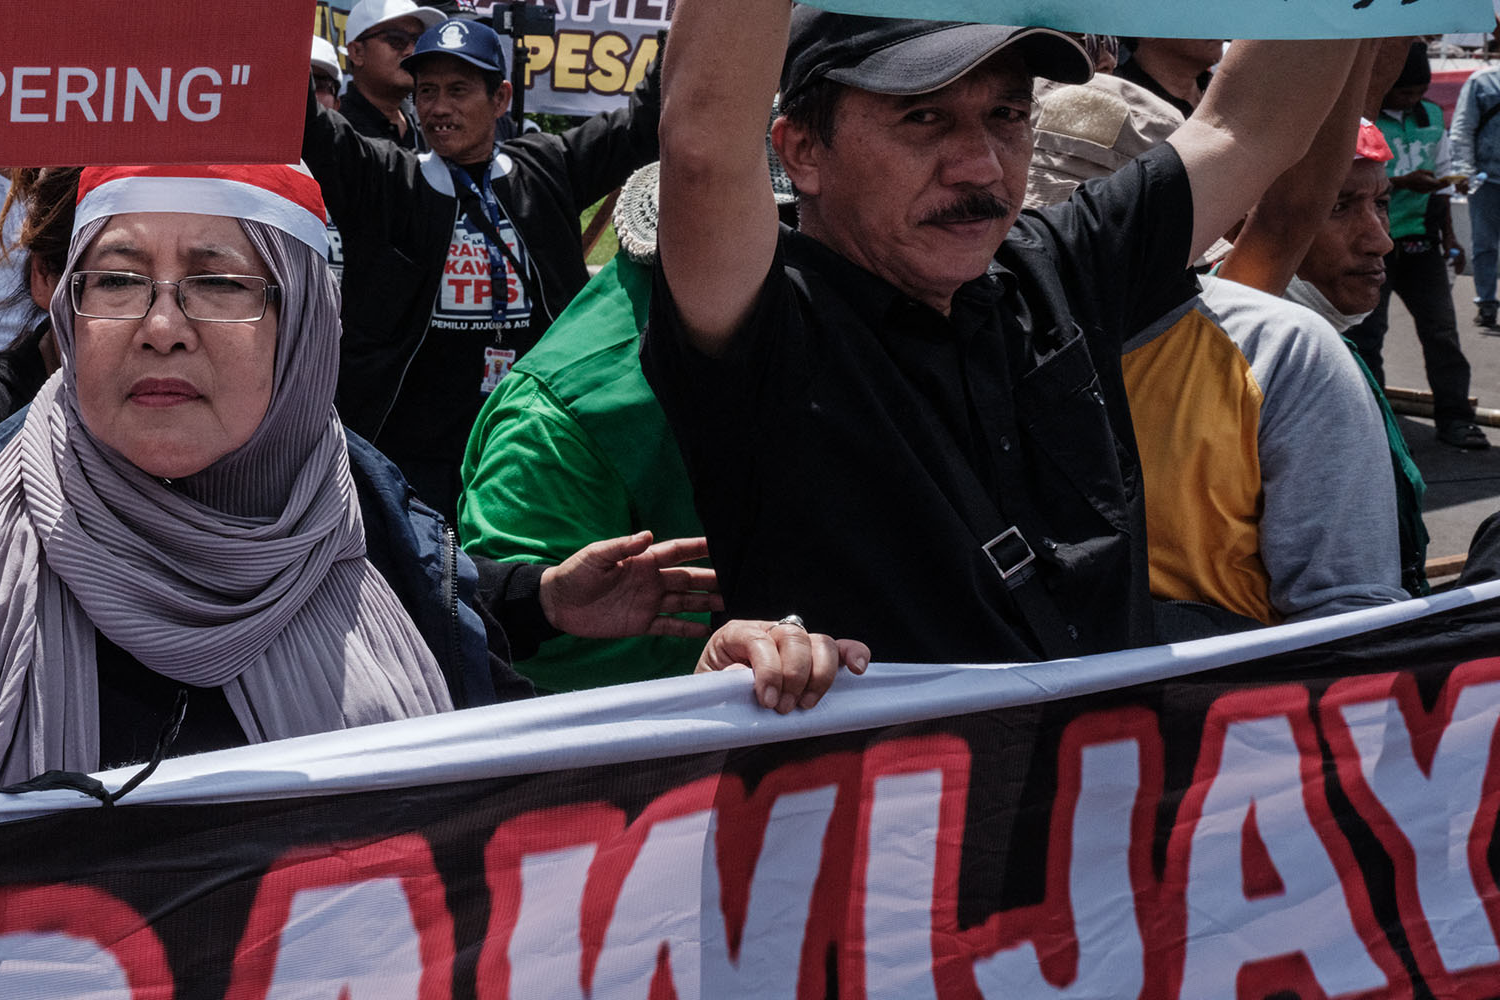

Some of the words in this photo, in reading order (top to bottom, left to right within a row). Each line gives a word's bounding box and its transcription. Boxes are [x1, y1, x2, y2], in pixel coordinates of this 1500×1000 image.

[444, 260, 517, 276] KAWL
[447, 278, 519, 305] TPS
[431, 319, 468, 330] PEMILU
